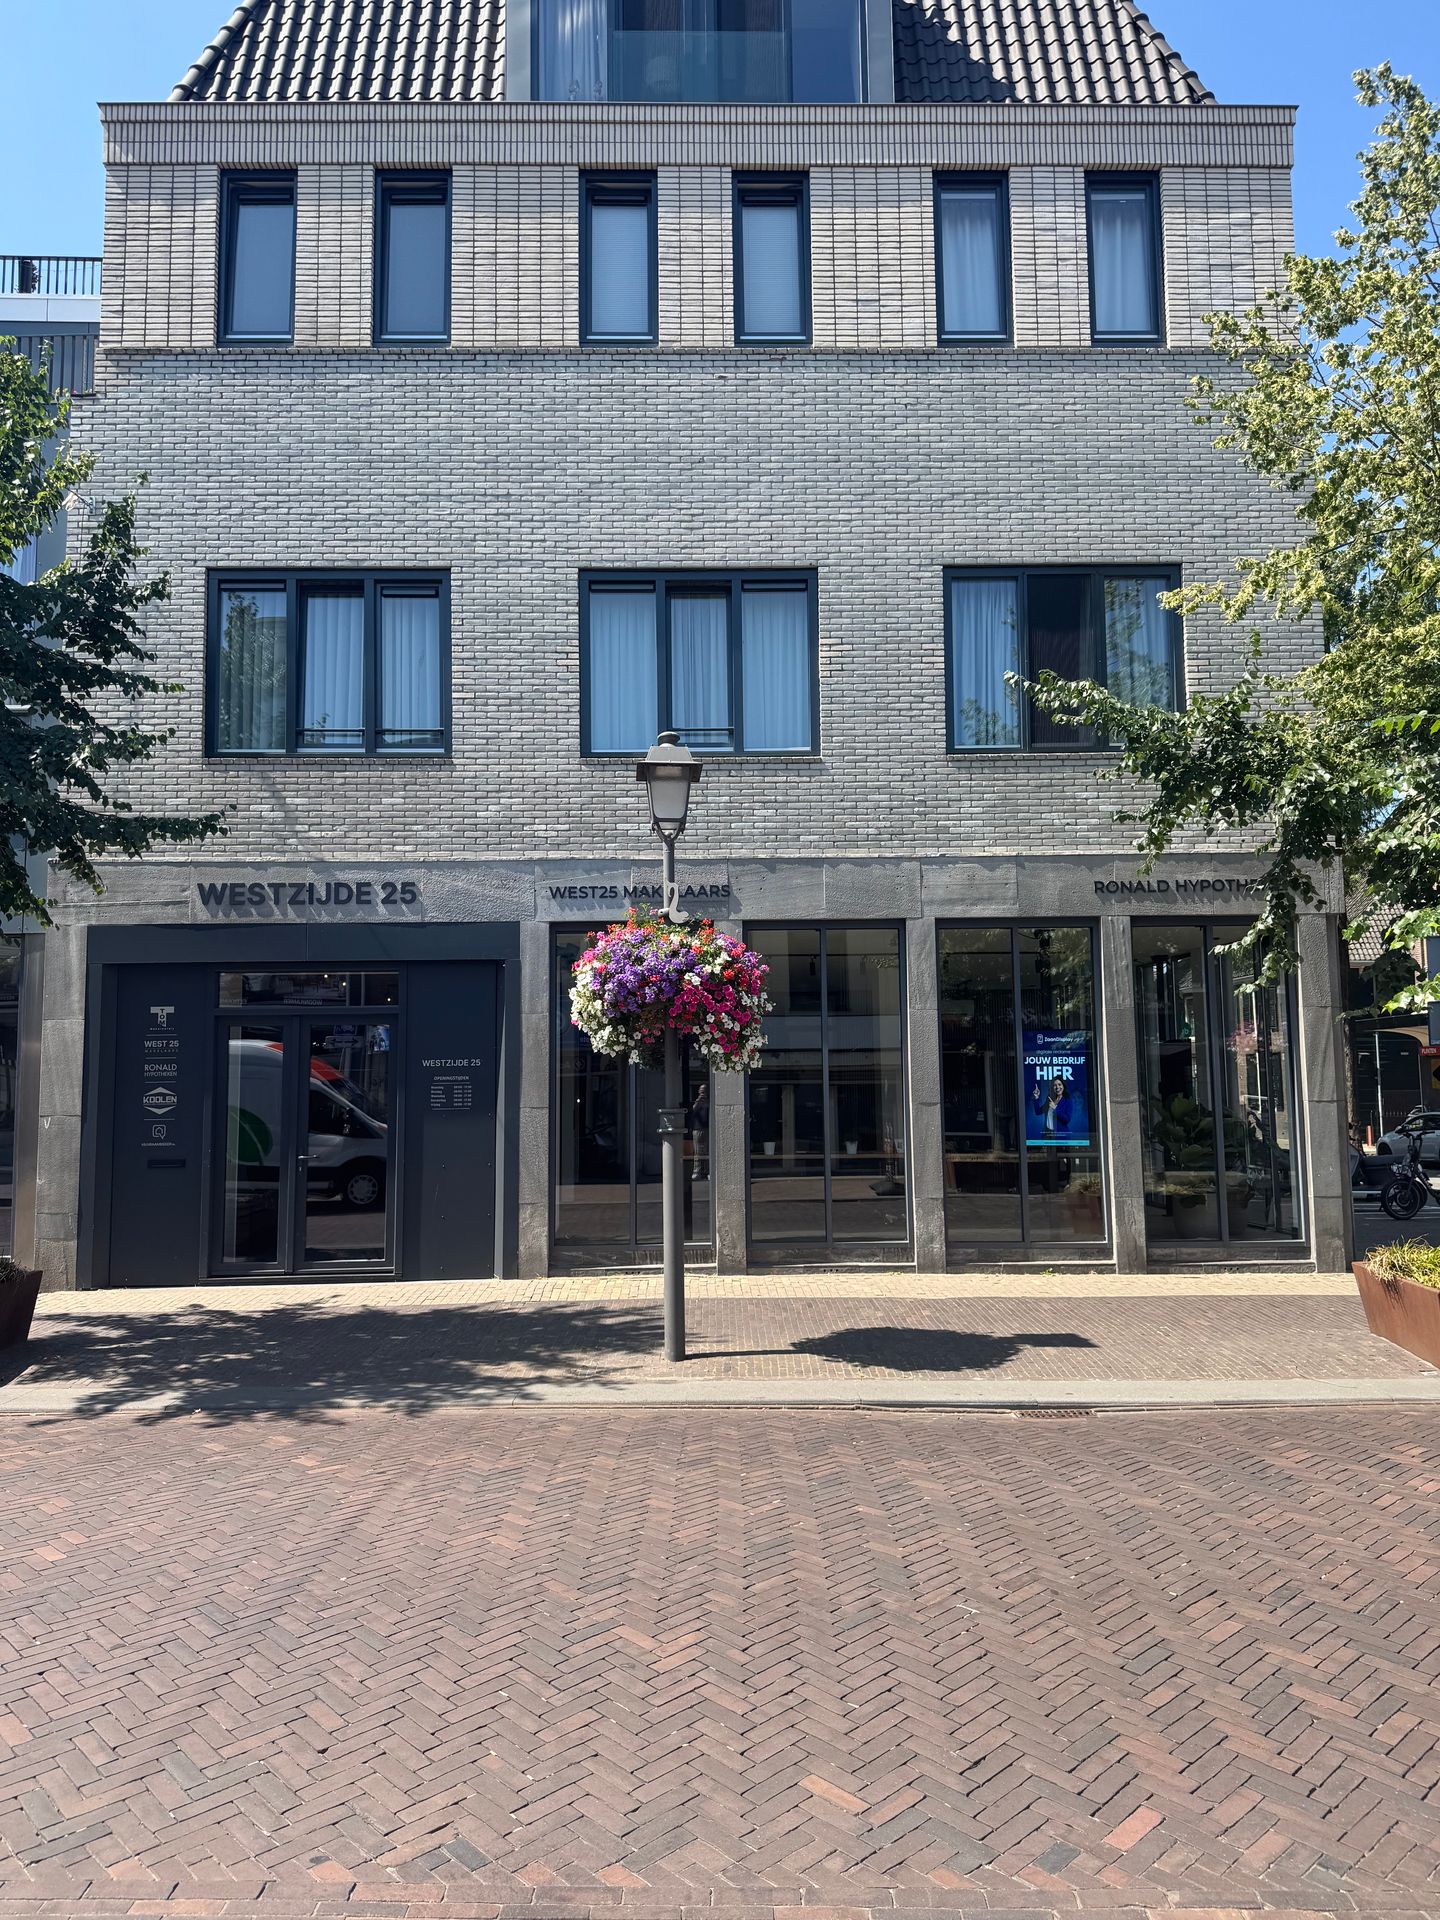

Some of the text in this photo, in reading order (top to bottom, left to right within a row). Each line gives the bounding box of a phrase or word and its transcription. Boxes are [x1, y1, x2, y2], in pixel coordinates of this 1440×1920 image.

[1094, 878, 1268, 894] RONALD HYPOTHE
[197, 882, 417, 906] WESTZIJDE 25
[549, 884, 731, 899] WEST25 MAKAARS
[144, 1040, 180, 1048] WEST 25
[422, 1059, 469, 1067] WESTZIJDE
[1024, 1056, 1086, 1065] JOUW BEDRIJF
[144, 1063, 178, 1072] RONALD
[1036, 1066, 1075, 1080] HIER
[143, 1096, 178, 1104] KOOLEN
